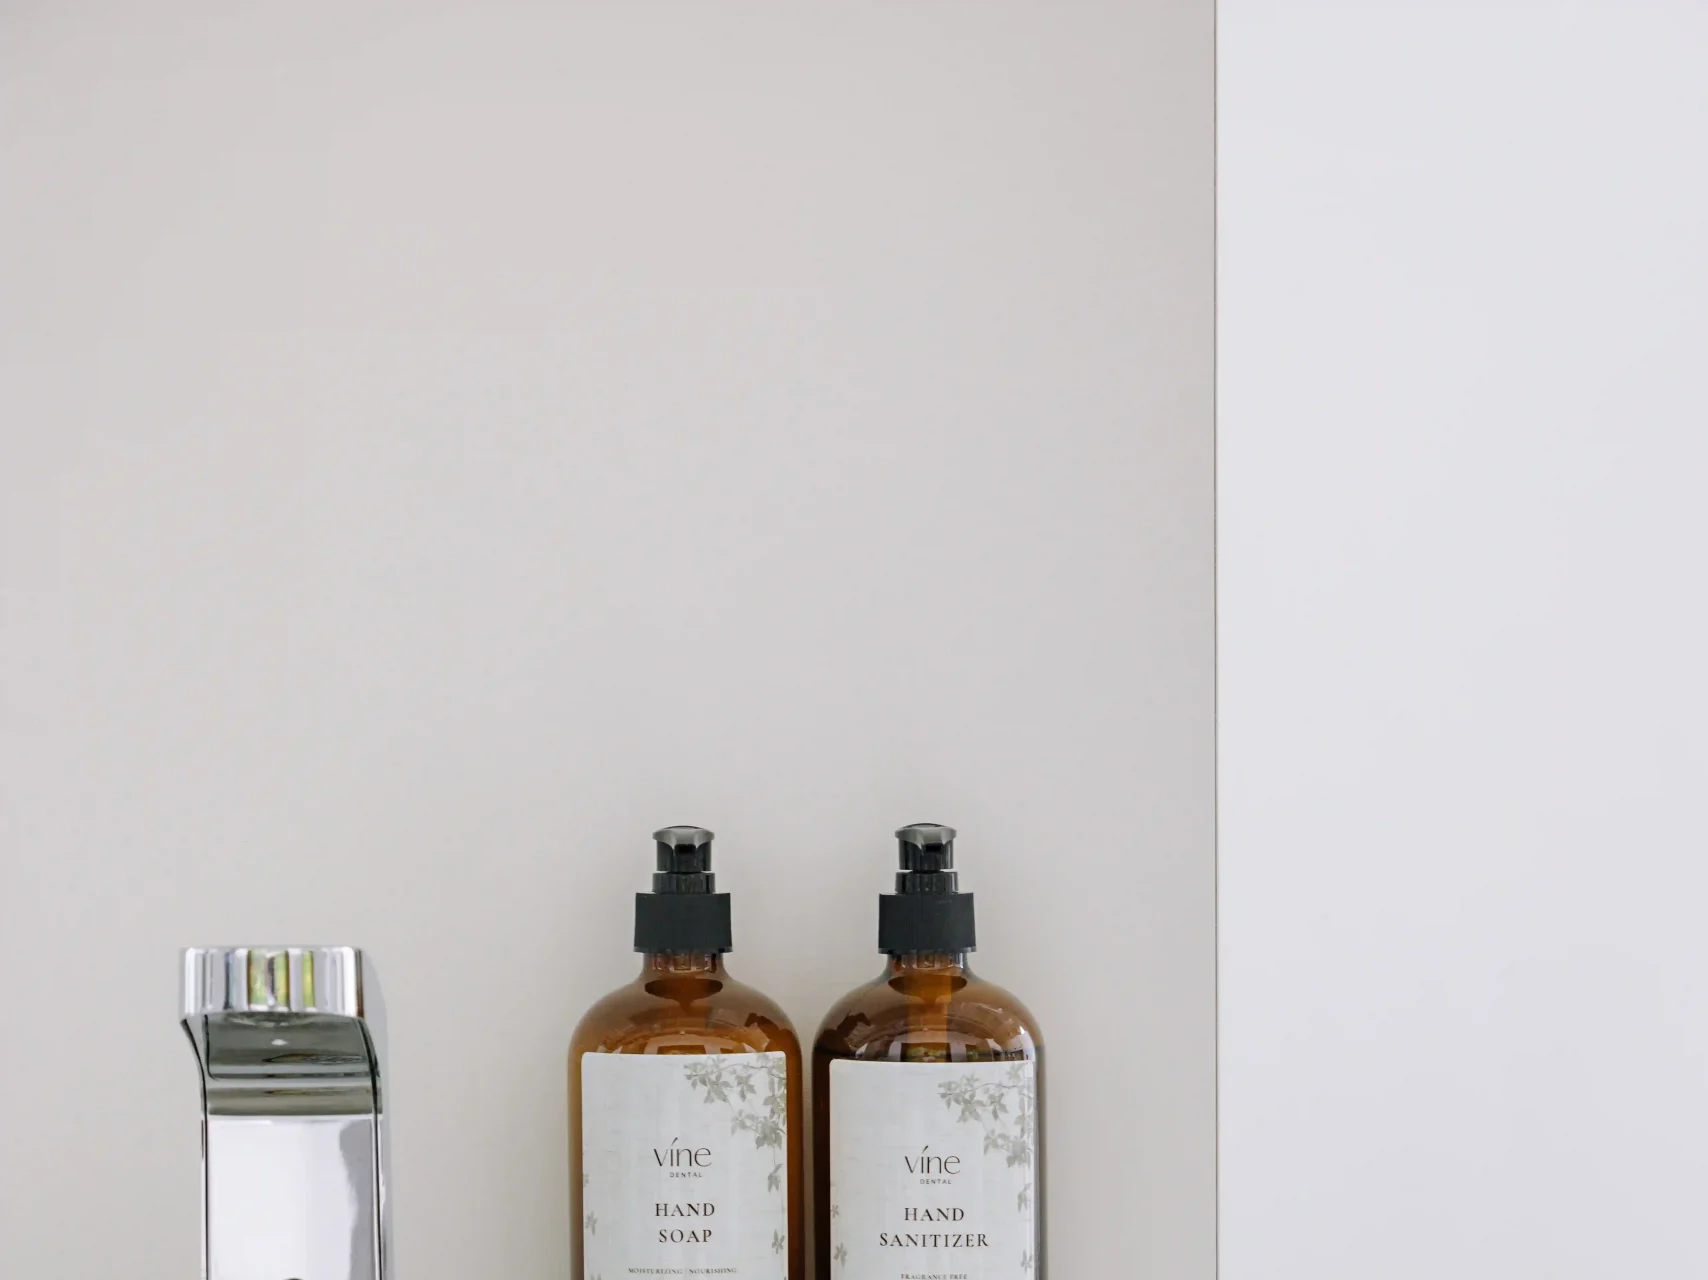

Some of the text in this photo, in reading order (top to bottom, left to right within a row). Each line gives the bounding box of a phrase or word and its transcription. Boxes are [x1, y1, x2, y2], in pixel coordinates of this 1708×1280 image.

[655, 1202, 716, 1217] HAND
[904, 1207, 965, 1222] HAND
[658, 1228, 712, 1243] SOAP
[879, 1232, 989, 1248] SANITIZER
